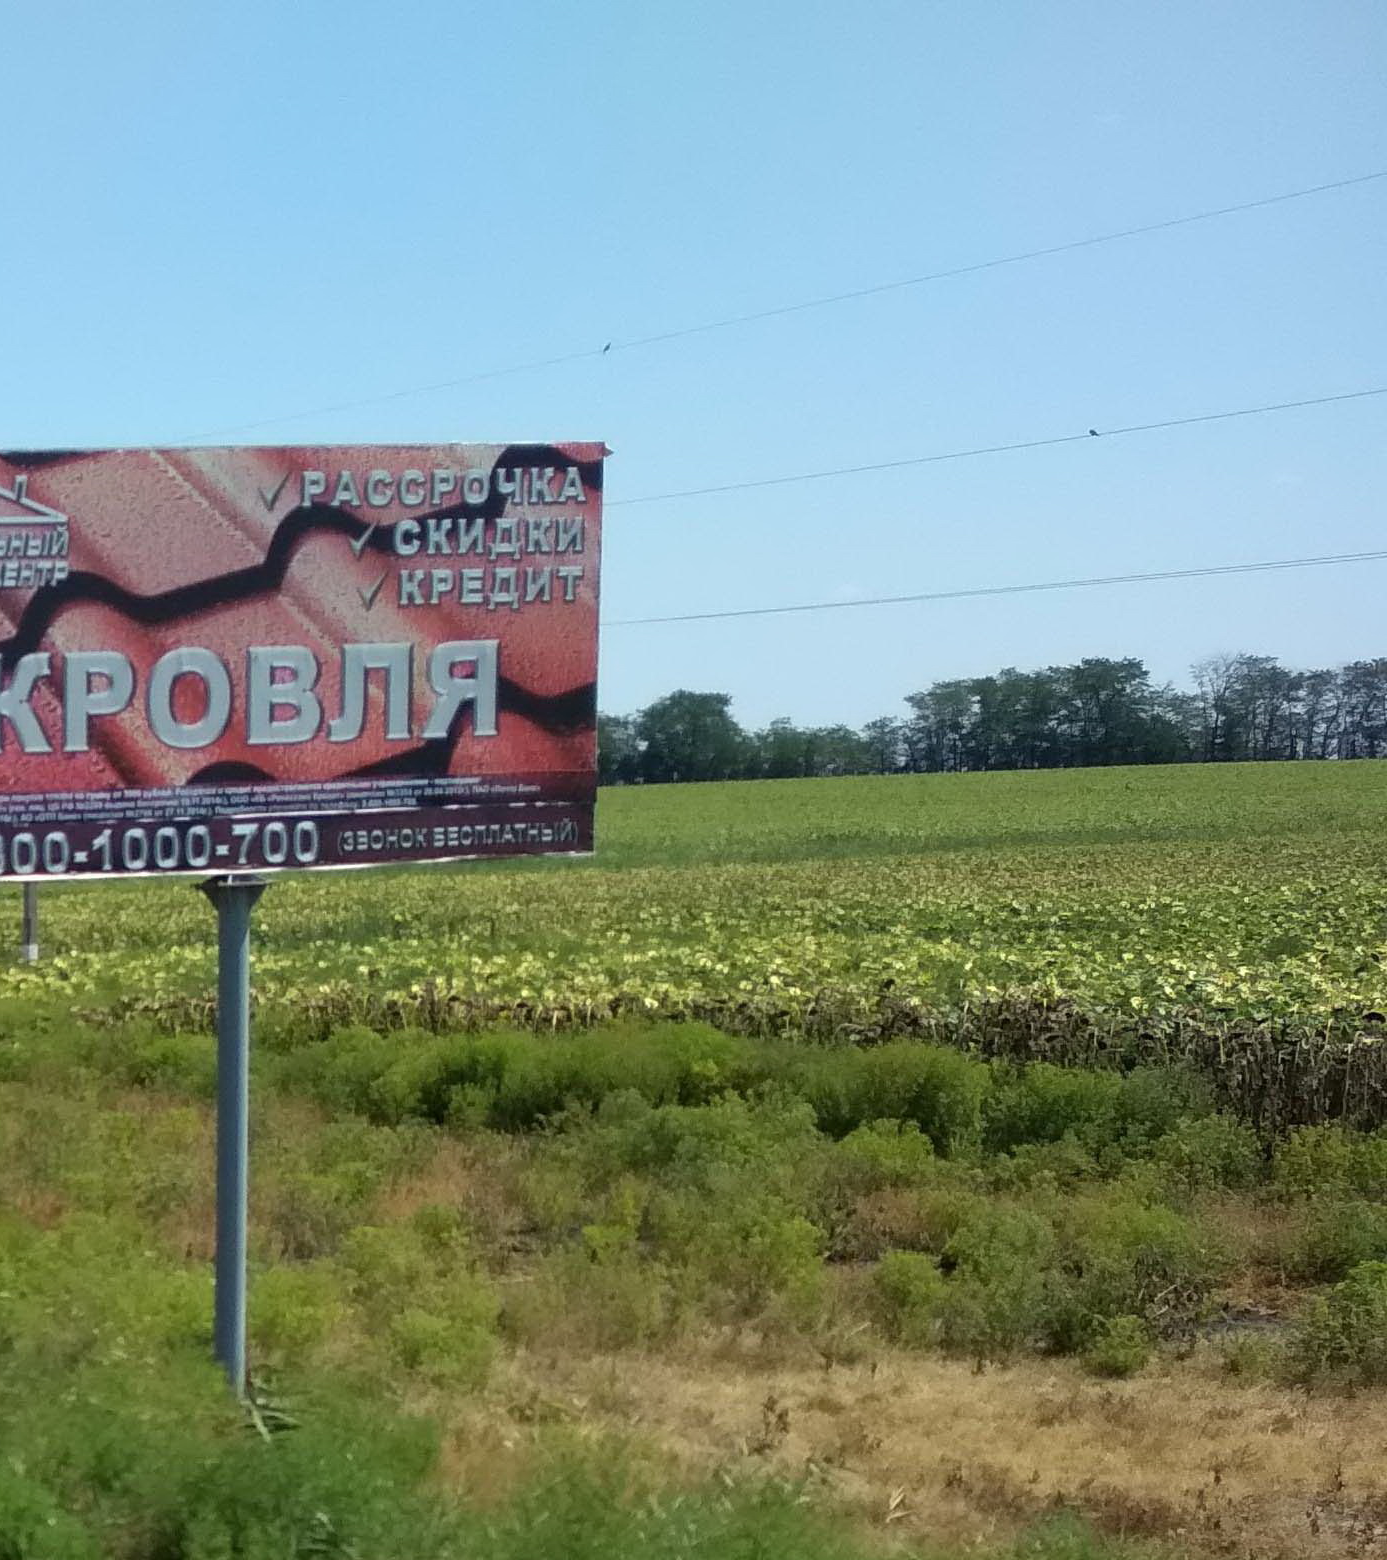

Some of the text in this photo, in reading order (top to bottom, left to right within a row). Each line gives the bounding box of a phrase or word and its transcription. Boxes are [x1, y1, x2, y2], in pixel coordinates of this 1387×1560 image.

[300, 465, 588, 508] РАССРОЧКА
[391, 516, 586, 560] СКИДКИ
[398, 566, 585, 610] КРЕДИТ
[336, 827, 428, 857] (ЗВОНОК
[431, 817, 579, 849] БЕСПЛАТНЫЙ)
